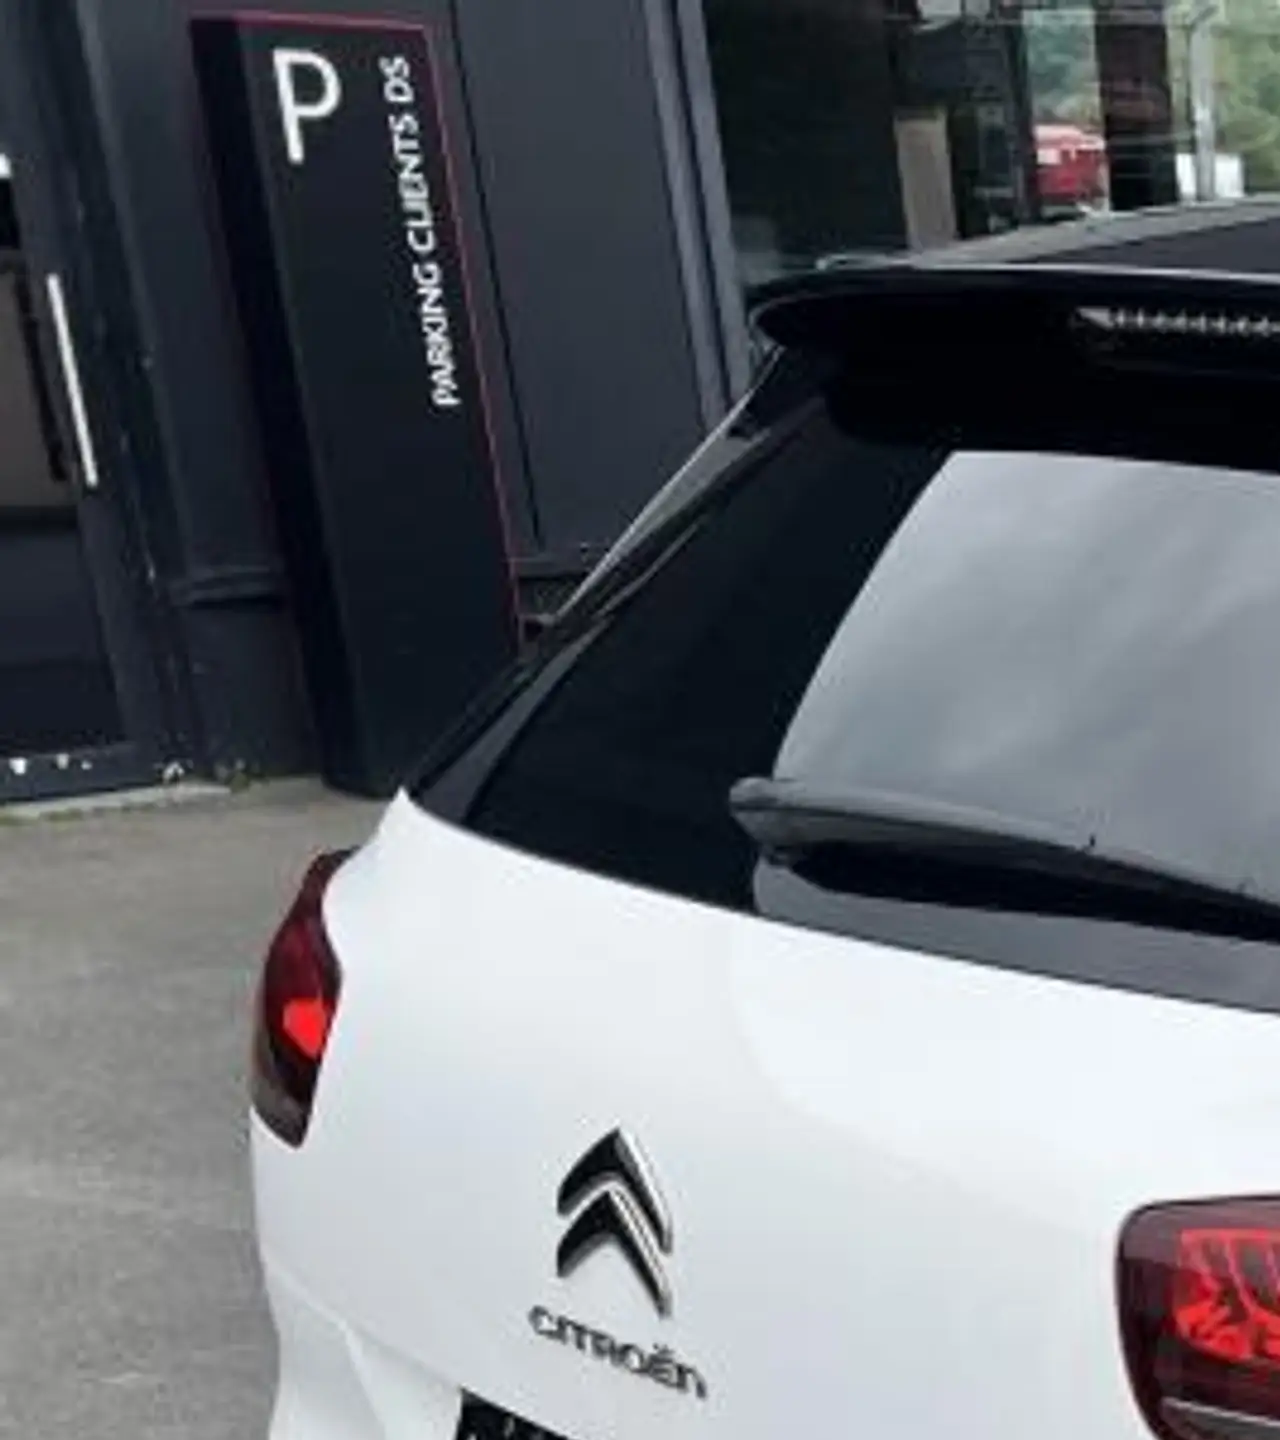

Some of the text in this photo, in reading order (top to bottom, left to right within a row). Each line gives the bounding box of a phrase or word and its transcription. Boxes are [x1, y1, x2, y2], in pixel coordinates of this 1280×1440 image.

[273, 48, 342, 164] P
[379, 55, 461, 406] PARKING CLIENTS DS
